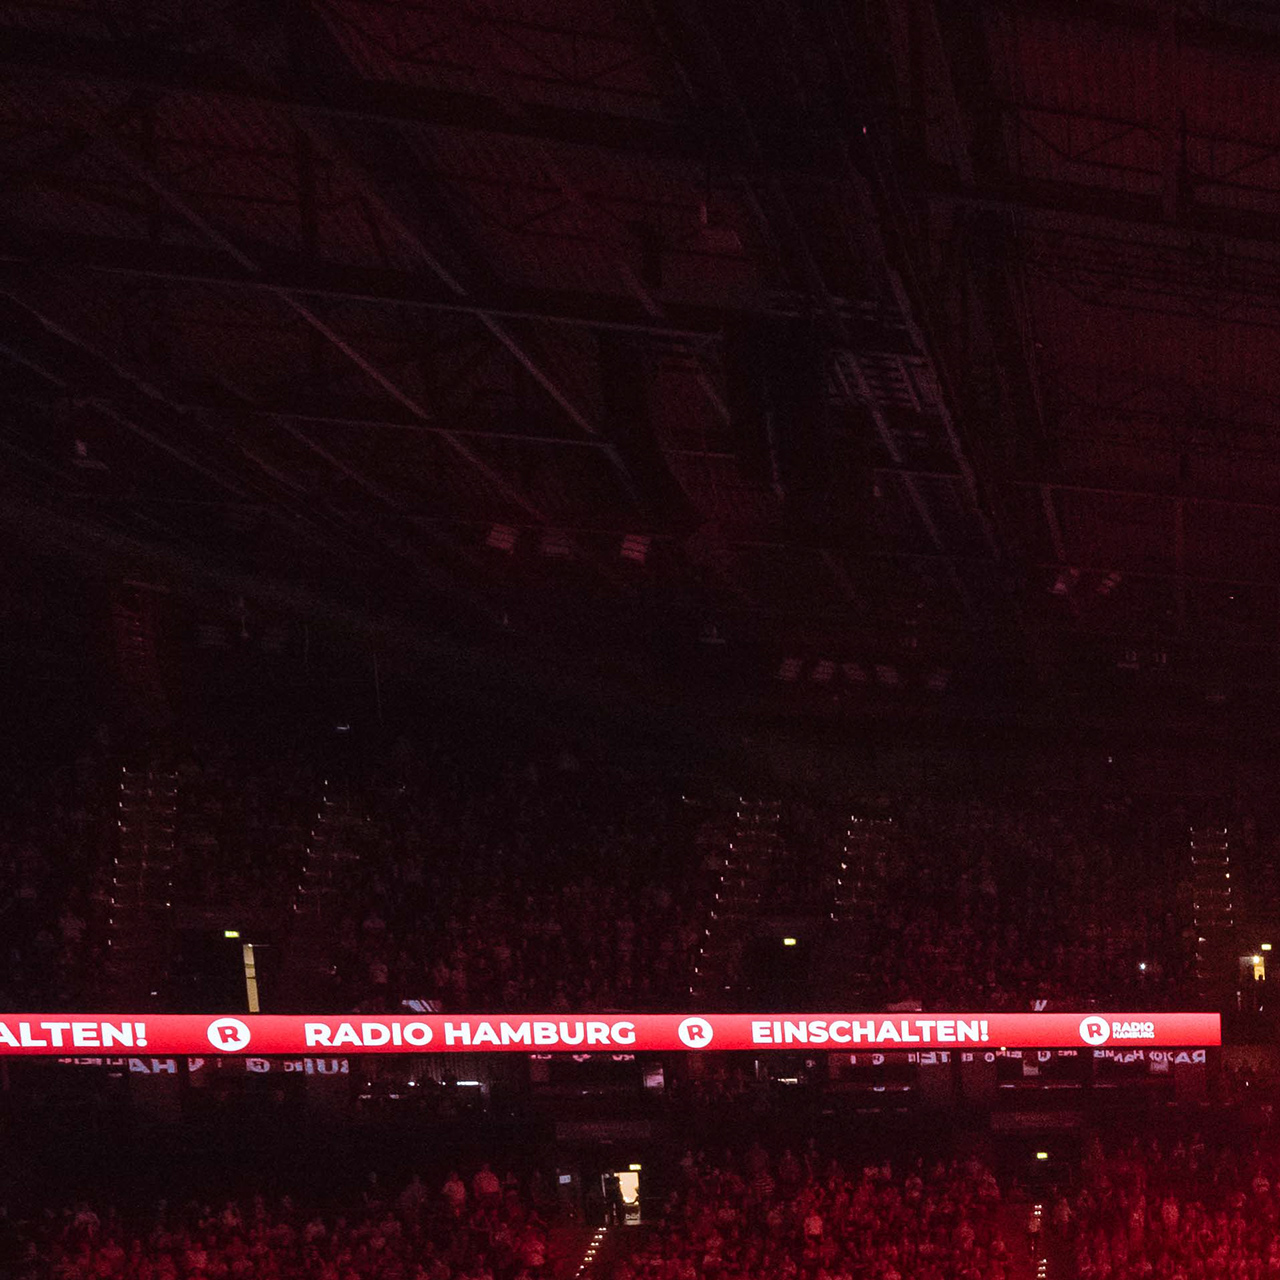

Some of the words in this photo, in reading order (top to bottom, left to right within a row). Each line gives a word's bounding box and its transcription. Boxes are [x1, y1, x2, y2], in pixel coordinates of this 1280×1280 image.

[0, 1021, 147, 1047] ALTEN!
[304, 1022, 433, 1046] RADIO
[443, 1021, 636, 1046] HAMBURG
[751, 1019, 989, 1044] EINSCHALTEN!
[1112, 1021, 1154, 1032] RADIO
